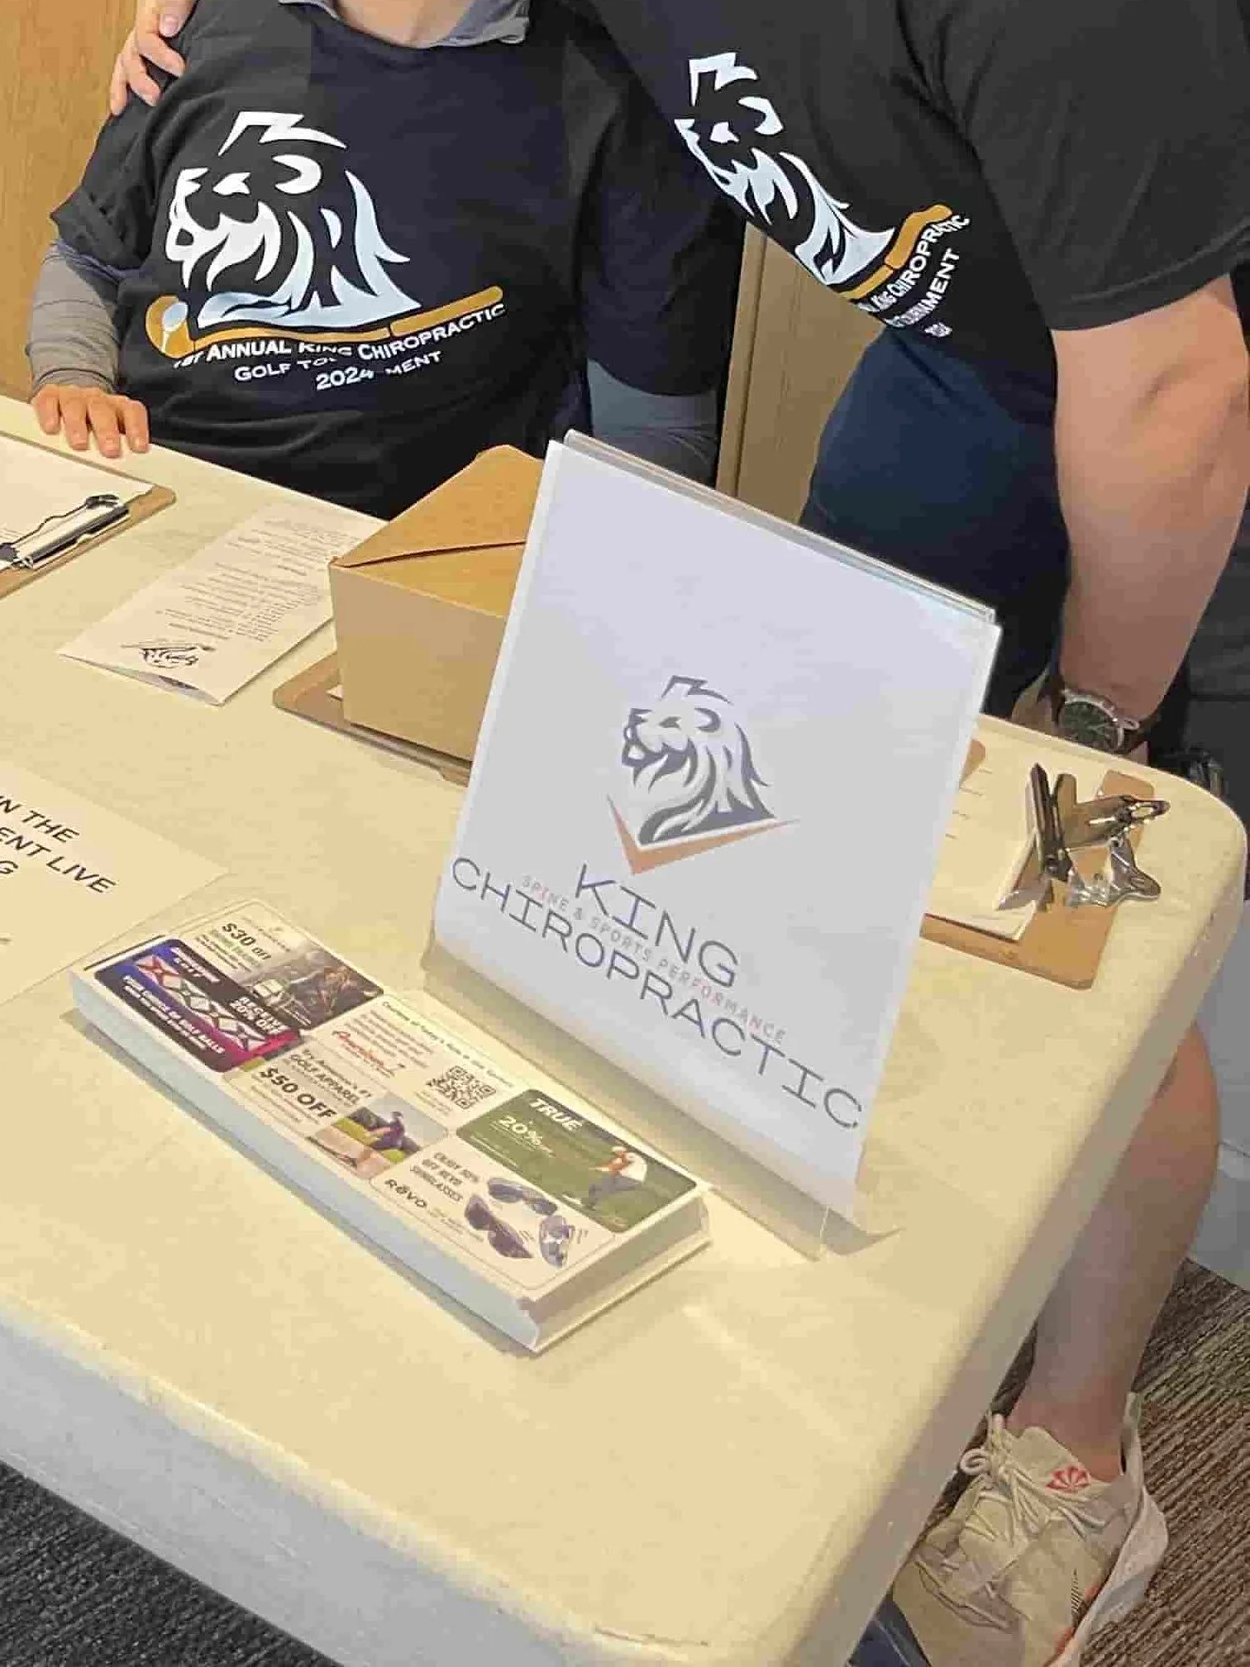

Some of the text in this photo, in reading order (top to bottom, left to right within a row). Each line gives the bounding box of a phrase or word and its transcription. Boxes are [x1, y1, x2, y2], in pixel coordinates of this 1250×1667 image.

[206, 339, 292, 362] ANNUAL
[357, 303, 507, 362] CHIROPRACTIC
[233, 362, 292, 382] GOLF
[315, 365, 375, 392] 2024
[17, 809, 80, 844] THE
[46, 852, 117, 894] LIVE
[222, 922, 255, 946] $30
[574, 863, 739, 988] KING
[521, 874, 570, 913] SPINE
[588, 915, 654, 962] SPORTS
[657, 957, 787, 1044] PERFORMANCE
[451, 857, 862, 1130] CHIROPRACTIC
[256, 1019, 282, 1035] OFF
[260, 1067, 299, 1093] $50
[297, 1094, 336, 1117] OFF
[498, 1115, 543, 1145] 20%
[528, 1098, 583, 1130] TRUE
